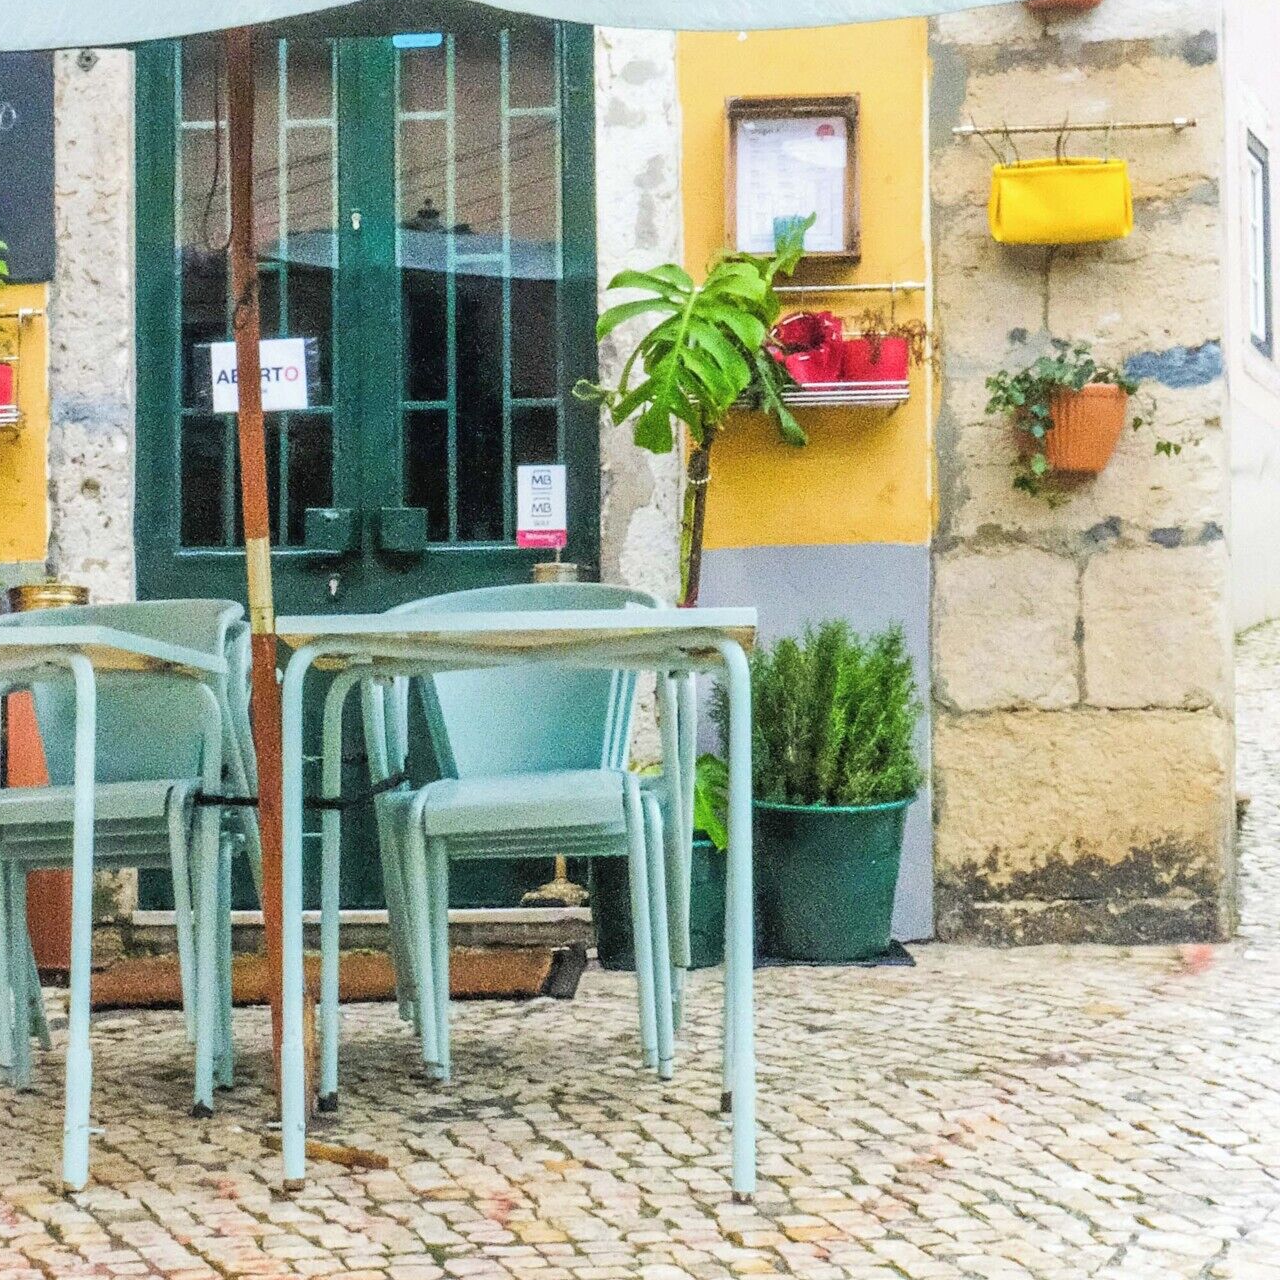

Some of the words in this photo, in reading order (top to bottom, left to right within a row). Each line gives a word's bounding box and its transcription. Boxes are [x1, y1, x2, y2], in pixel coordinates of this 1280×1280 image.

[216, 366, 299, 384] ABRTO
[531, 474, 552, 485] MB
[531, 502, 552, 513] MB
